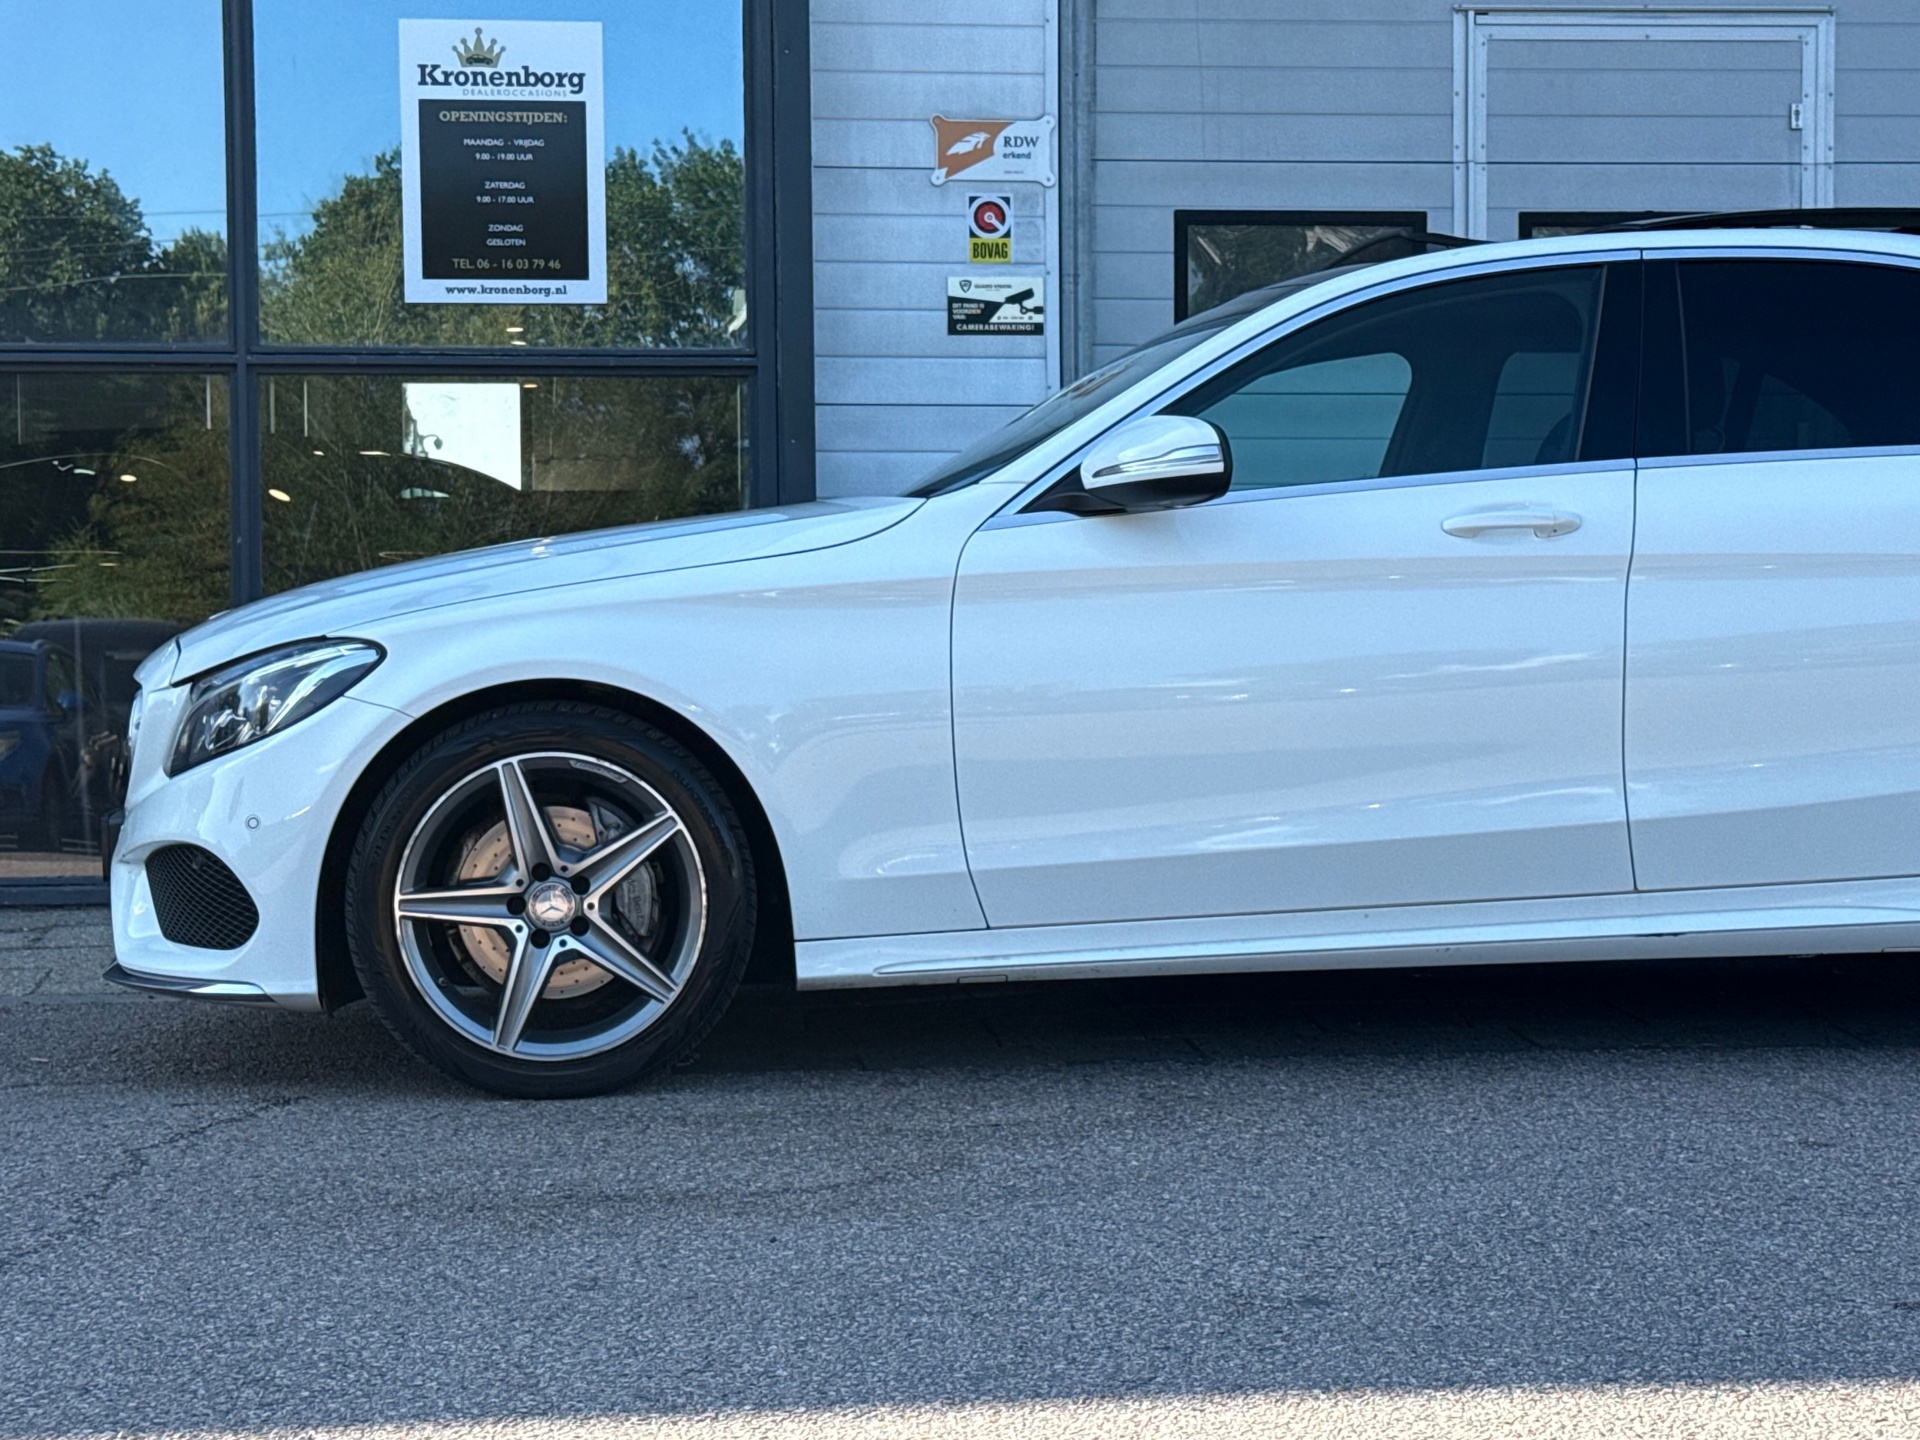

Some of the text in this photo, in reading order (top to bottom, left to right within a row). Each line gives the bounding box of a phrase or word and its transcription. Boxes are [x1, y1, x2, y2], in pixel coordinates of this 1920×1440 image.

[417, 64, 586, 94] Kronenborg
[462, 88, 567, 98] DEALEROCCASIONS
[439, 110, 568, 126] OPENINGSTIJDEN:
[463, 138, 504, 147] MAANDAG
[513, 138, 545, 148] VRIJDAG
[1003, 136, 1040, 148] RDW
[475, 153, 490, 161] 9.00
[497, 153, 515, 161] 19.00
[516, 153, 533, 161] UUR
[1002, 151, 1031, 160] erkend
[484, 181, 525, 190] ZATERDAG
[475, 196, 491, 204] 9.00
[497, 196, 515, 204] 17.00
[517, 196, 534, 204] UUR
[488, 224, 524, 232] ZONDAG
[486, 238, 526, 247] GESLOTEN
[972, 242, 1009, 259] BOVAG
[477, 258, 490, 269] 06
[501, 258, 514, 269] 16
[516, 258, 529, 269] 03
[532, 258, 545, 269] 79
[547, 258, 561, 269] 46
[445, 284, 567, 297] www.kronenborg.nl
[956, 323, 1035, 331] CAMERABEWAKING!
